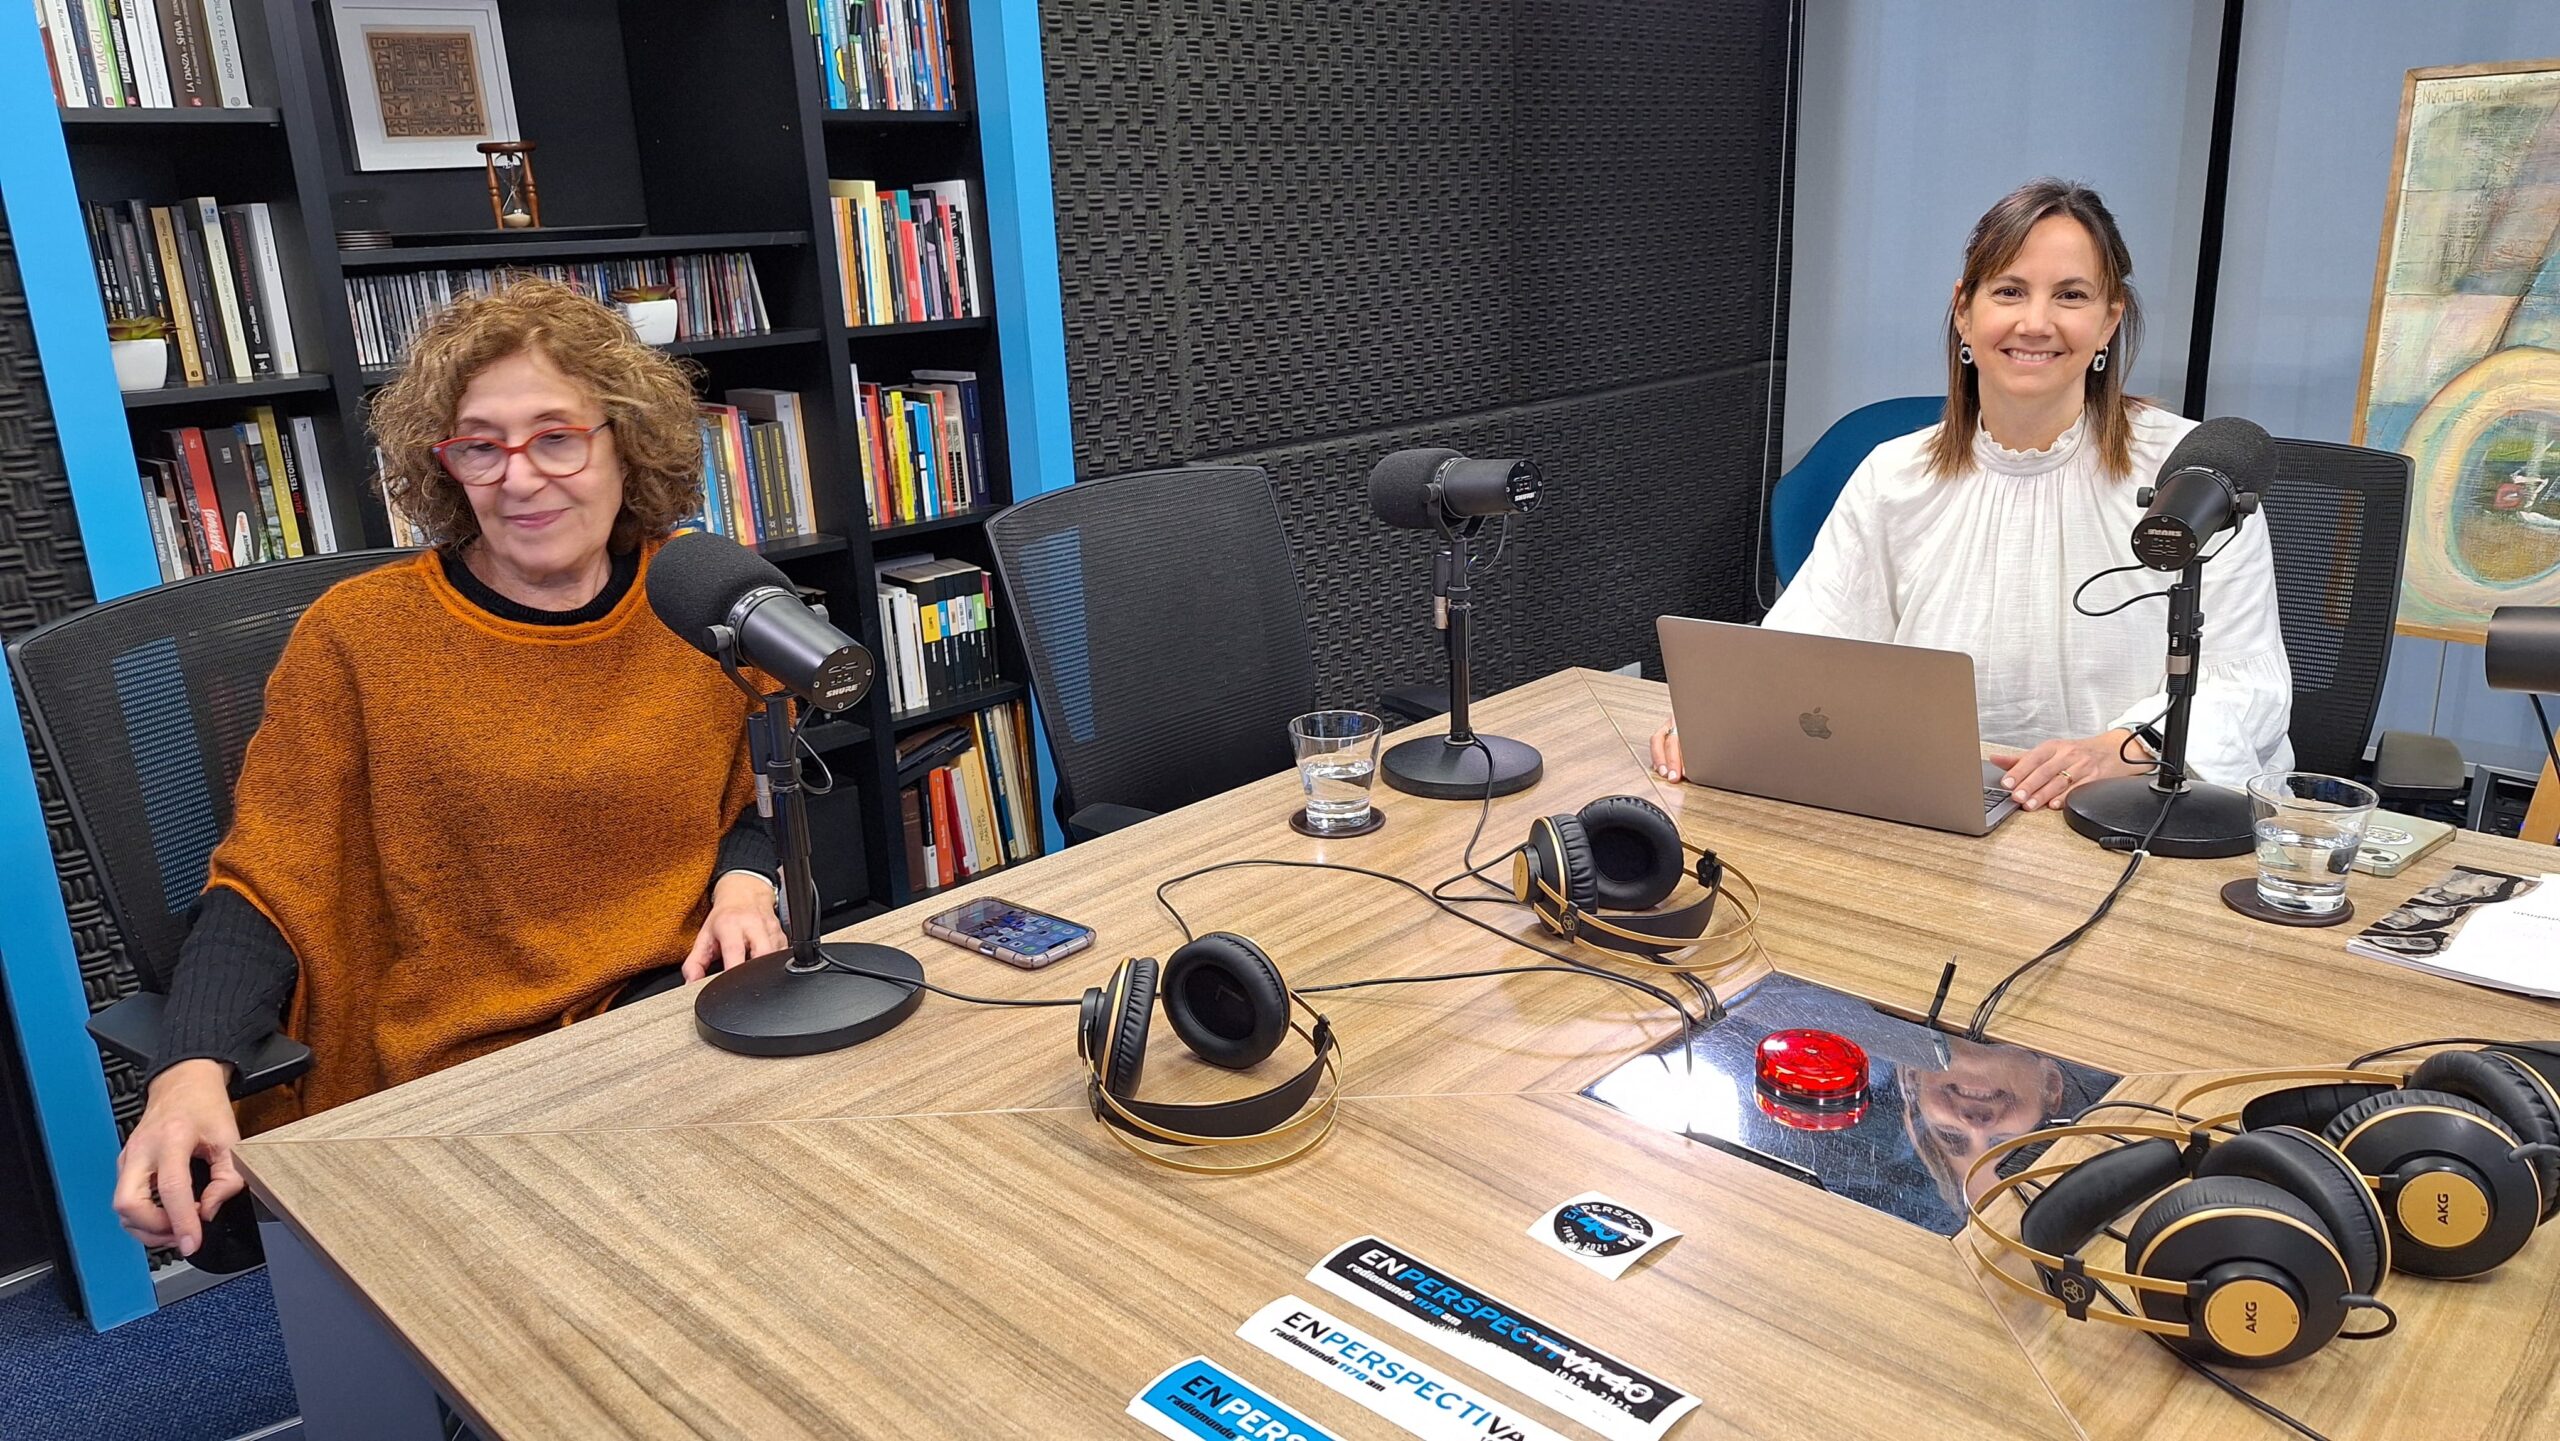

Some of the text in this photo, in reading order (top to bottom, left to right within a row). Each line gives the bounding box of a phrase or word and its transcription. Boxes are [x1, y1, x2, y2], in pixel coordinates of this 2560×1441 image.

[172, 19, 185, 46] SHIVA
[218, 29, 226, 38] EL
[90, 28, 108, 74] MAGGI
[179, 52, 192, 80] DANZA
[220, 39, 234, 79] DICTADOR
[184, 82, 195, 93] LA
[220, 265, 228, 294] REPÚBLICA
[251, 323, 261, 344] Claudio
[757, 430, 766, 459] DICCIONARIO
[762, 466, 771, 493] LITERATURA
[774, 428, 782, 457] DICCIONARIO
[779, 464, 787, 490] LITERATURA
[825, 684, 858, 698] SHURE
[2436, 1193, 2449, 1225] AKG
[1346, 1263, 1463, 1327] radiomundo 1170 am
[2245, 1301, 2258, 1334] AKG
[1270, 1327, 1387, 1392] radiomundo 1170 am
[1167, 1394, 1236, 1440] radiomundo
